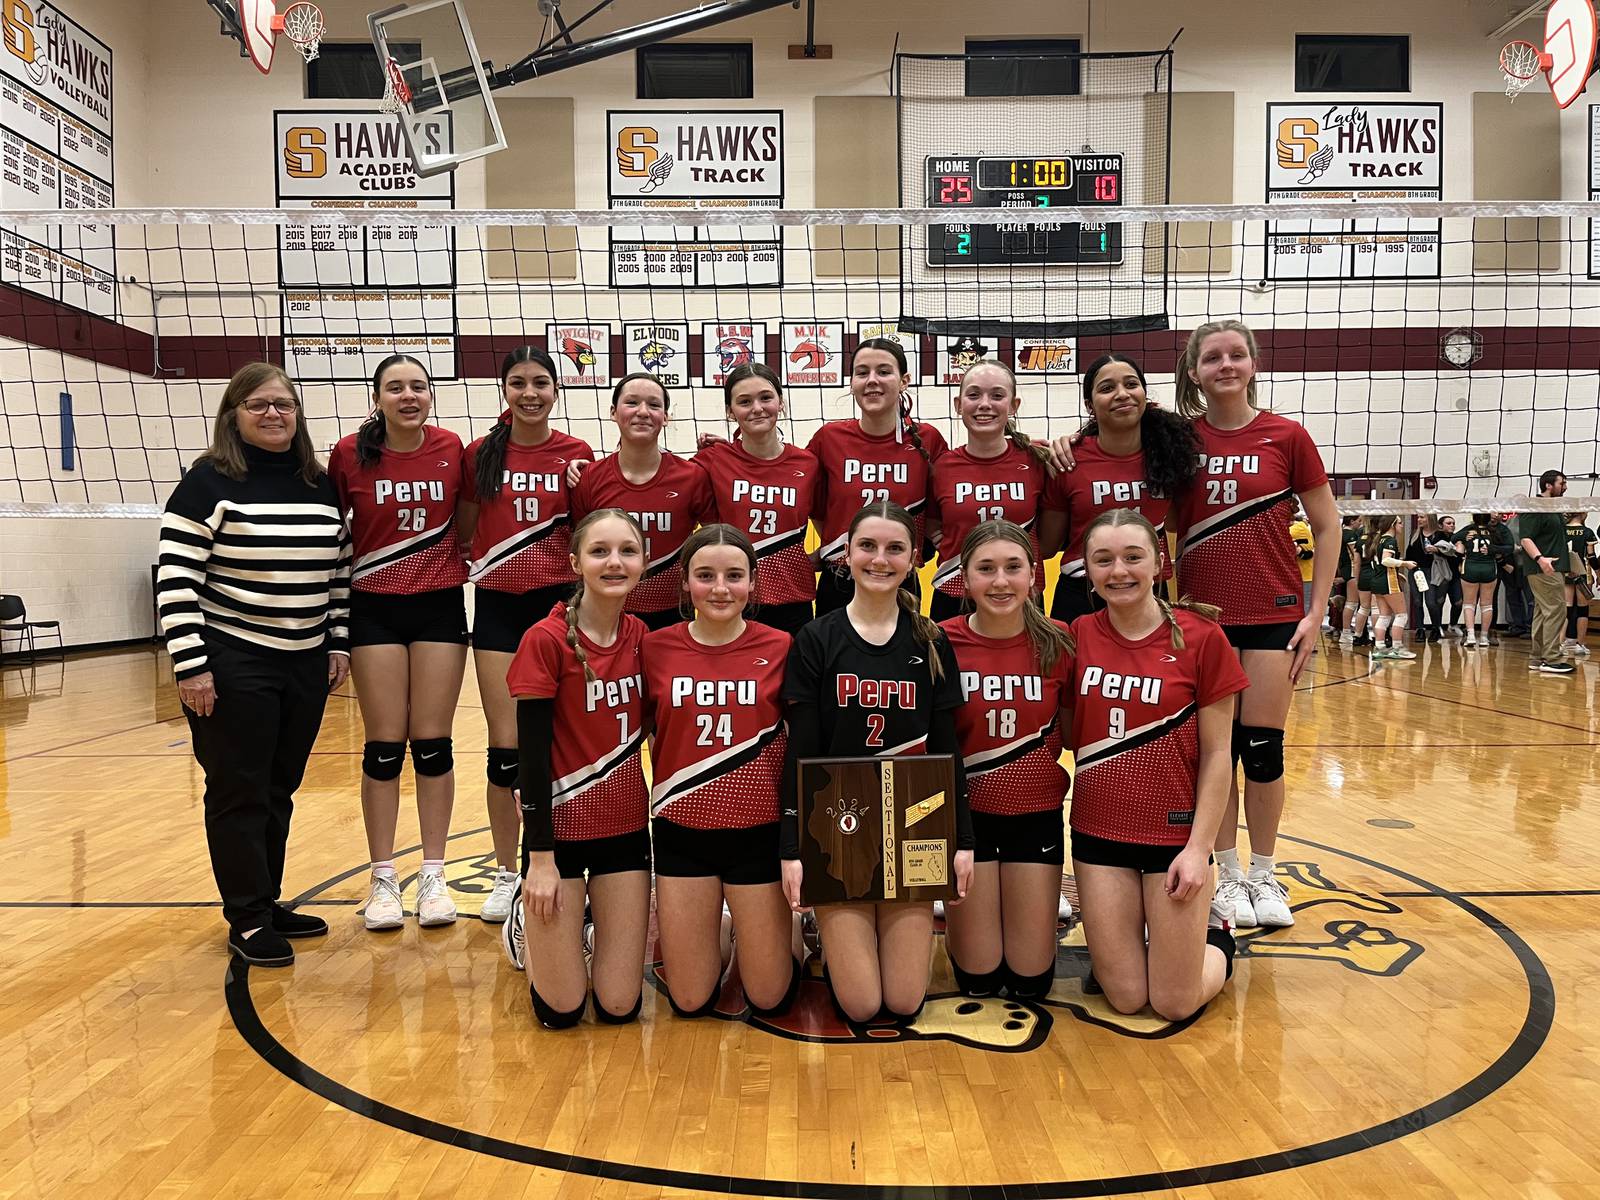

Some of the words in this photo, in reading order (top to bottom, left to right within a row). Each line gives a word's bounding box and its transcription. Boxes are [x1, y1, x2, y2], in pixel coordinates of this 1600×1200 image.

[35, 4, 67, 46] Lady
[47, 29, 109, 100] HAWKS
[50, 67, 109, 121] VOLLEYBALL
[1322, 106, 1368, 132] Lady
[677, 126, 776, 162] HAWKS
[1337, 118, 1436, 154] HAWKS
[339, 162, 416, 177] ACADEM
[690, 167, 765, 183] TRACK
[936, 160, 970, 173] HOME
[1010, 160, 1066, 187] 1:00
[1074, 158, 1120, 172] VISITOR
[1349, 161, 1423, 178] TRACK
[359, 177, 416, 191] CLUBS
[940, 177, 973, 203] 25
[1094, 175, 1116, 200] 10
[624, 199, 643, 207] GRADE
[643, 200, 696, 208] CONFERENCE
[699, 200, 748, 208] CHAMPIONS
[1001, 200, 1032, 208] PERIOD
[1007, 192, 1025, 200] POSS
[1357, 191, 1407, 199] CHAMPIONS
[286, 231, 305, 240] 2015
[312, 231, 331, 240] 2017
[945, 224, 971, 232] FOULS
[996, 224, 1028, 232] PLAYER
[1034, 223, 1061, 231] FOULS
[1079, 222, 1106, 231] FOULS
[957, 234, 970, 254] 2
[1100, 232, 1106, 252] 1
[1385, 244, 1405, 253] 1995
[1411, 244, 1433, 252] 2004
[617, 253, 637, 262] 1995
[643, 253, 666, 262] 2000
[700, 253, 723, 262] 2003
[727, 253, 749, 262] 2006
[753, 253, 775, 262] 2009
[617, 264, 639, 273] 2005
[643, 264, 666, 273] 2006
[670, 264, 692, 273] 2009
[290, 302, 311, 311] 2012
[553, 327, 604, 341] DWIGHT
[633, 326, 680, 341] ELWOOD
[795, 325, 830, 338] M.V.K.
[1047, 358, 1072, 371] West
[659, 373, 680, 385] ERS
[844, 458, 908, 484] Peru
[375, 479, 444, 505] Peru
[733, 480, 797, 507] Peru
[955, 482, 1025, 504] Peru
[1092, 480, 1165, 505] Per
[1206, 479, 1239, 505] 28
[513, 497, 539, 522] 19
[397, 508, 427, 532] 26
[627, 511, 672, 532] ru
[749, 509, 777, 535] 23
[671, 676, 757, 707] Peru
[836, 673, 917, 710] Peru
[960, 671, 1042, 702] Peru
[1080, 666, 1162, 705] Peru
[696, 713, 734, 747] 24
[865, 714, 884, 747] 2
[985, 708, 1017, 739] 18
[1107, 707, 1127, 740] 9
[826, 798, 870, 818] 2024
[884, 768, 894, 892] SECTIONAL
[907, 843, 943, 852] CHAMPIONS
